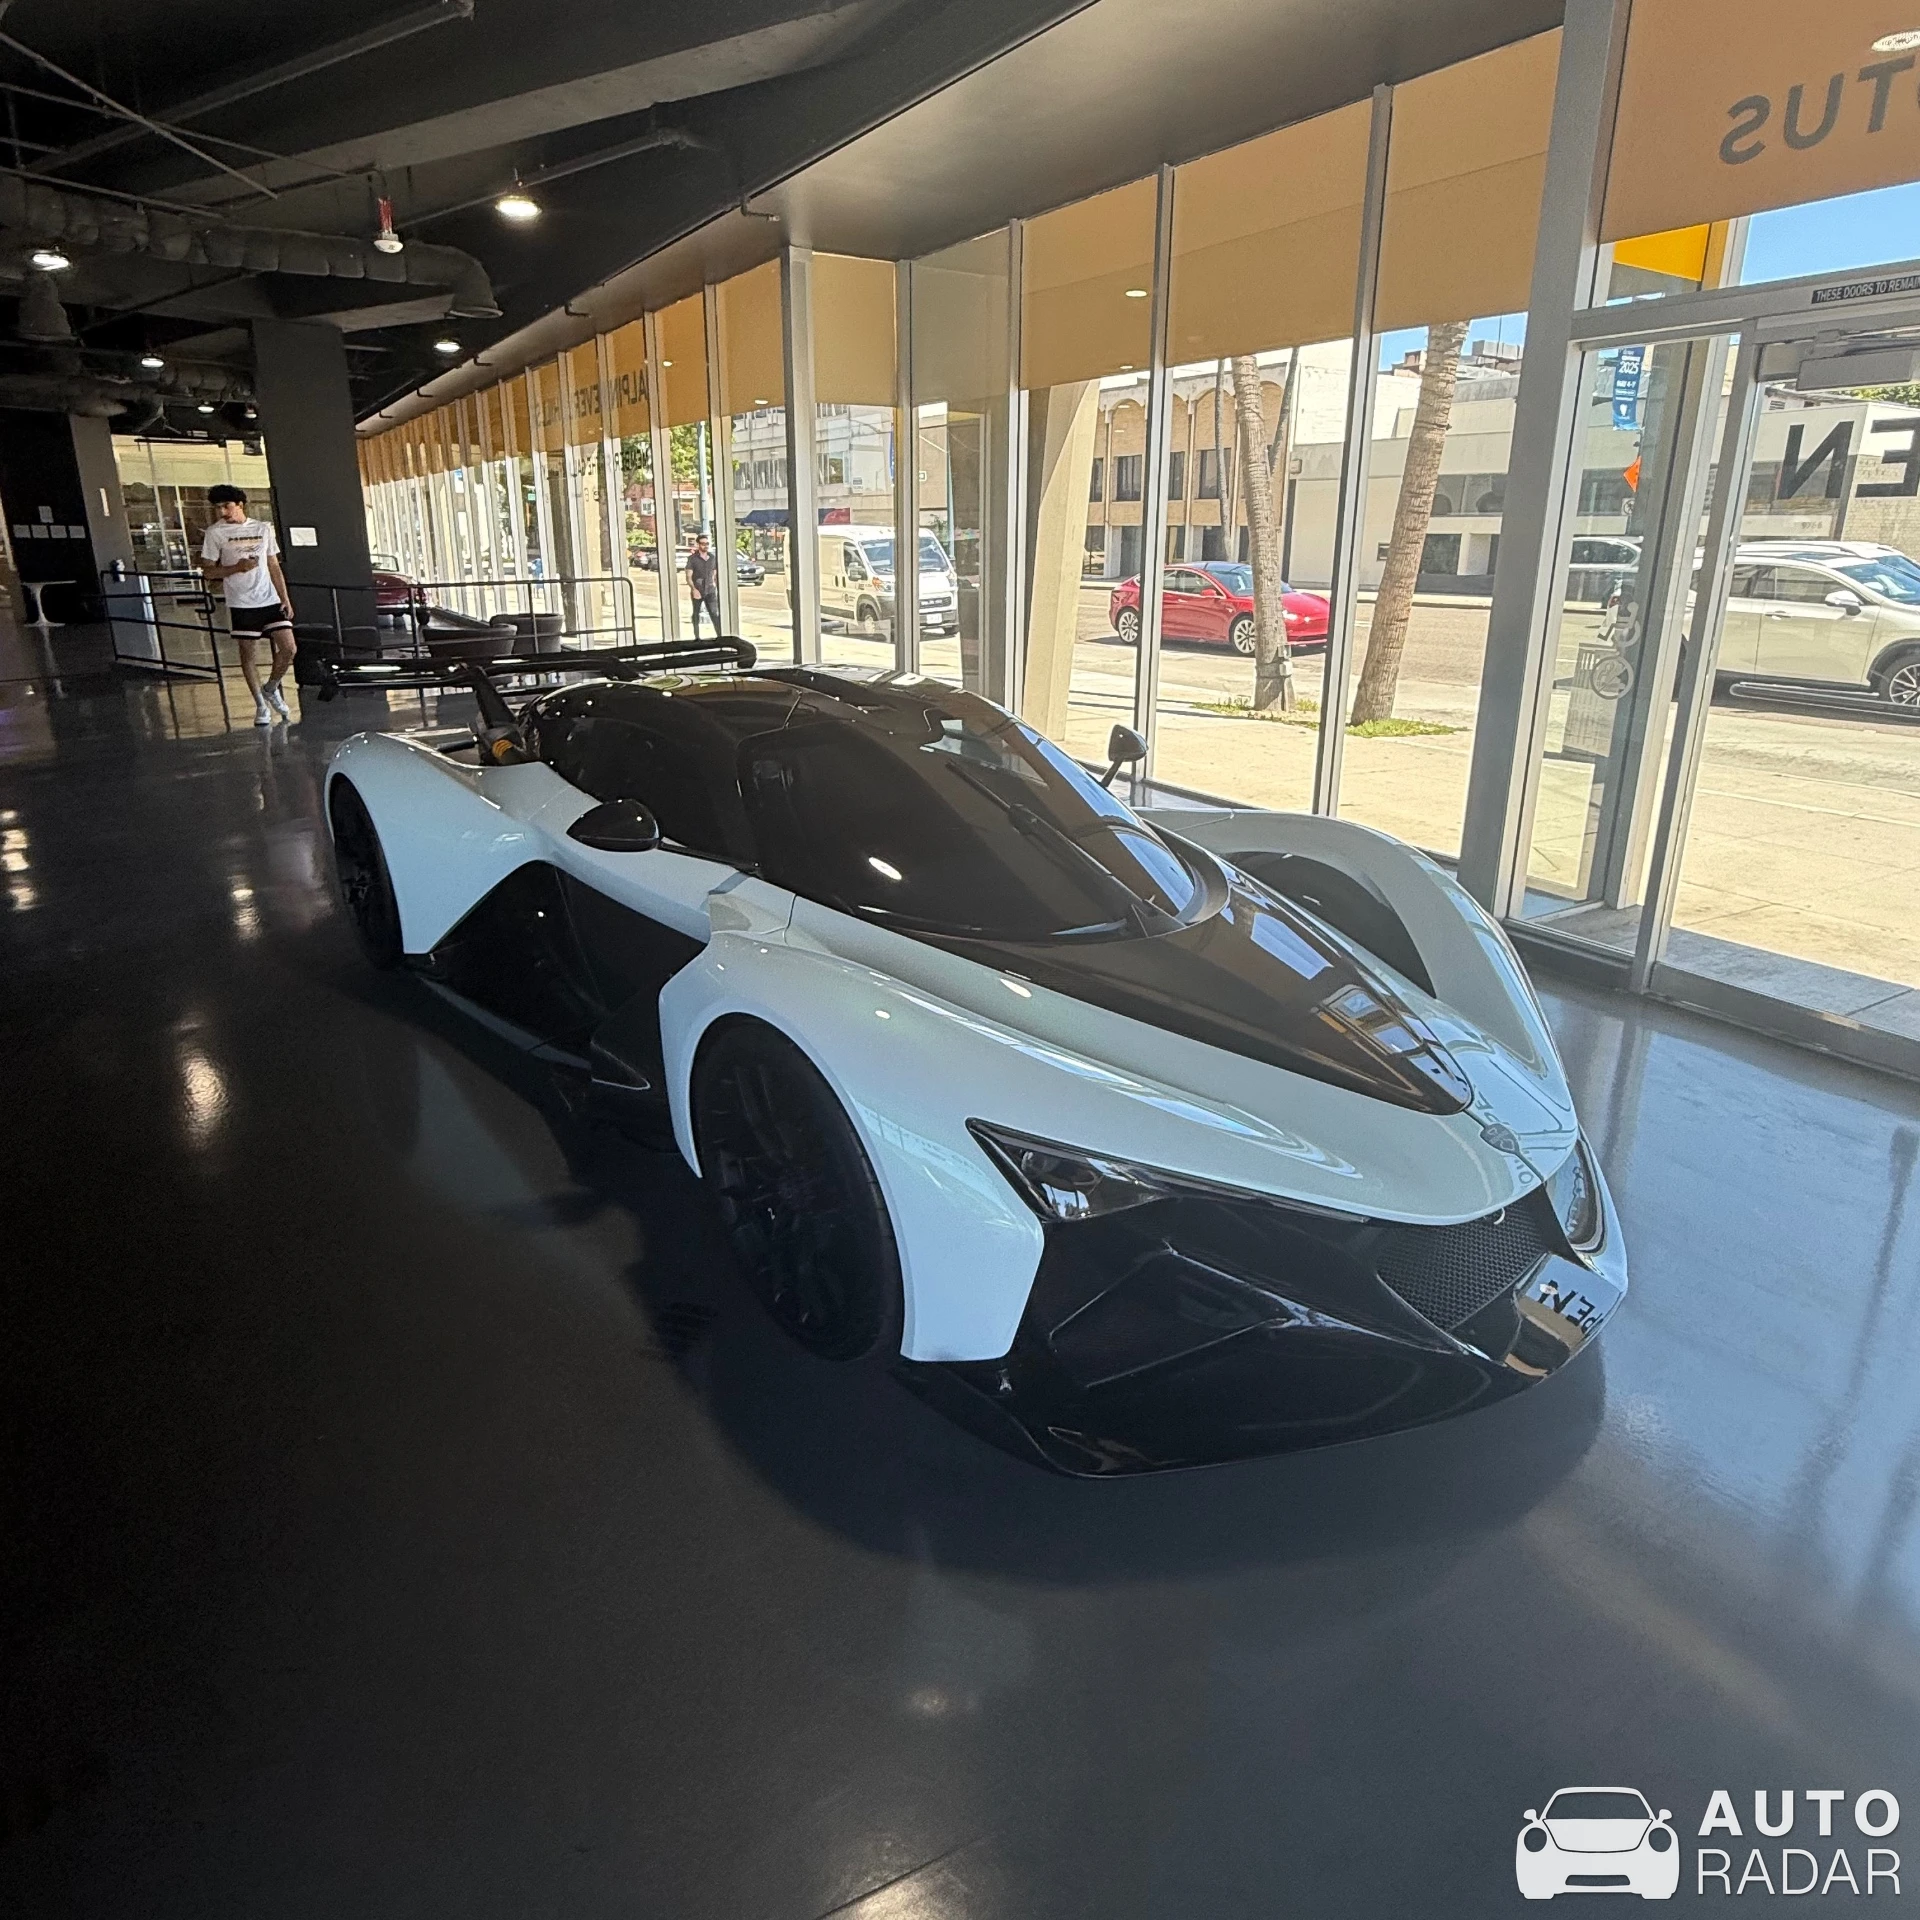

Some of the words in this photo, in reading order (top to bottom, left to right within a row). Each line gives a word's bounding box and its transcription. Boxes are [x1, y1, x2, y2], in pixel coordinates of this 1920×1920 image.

[1816, 288, 1842, 302] THESE
[1843, 283, 1873, 298] DOORS
[1875, 281, 1887, 293] TO
[1619, 361, 1640, 375] 2025
